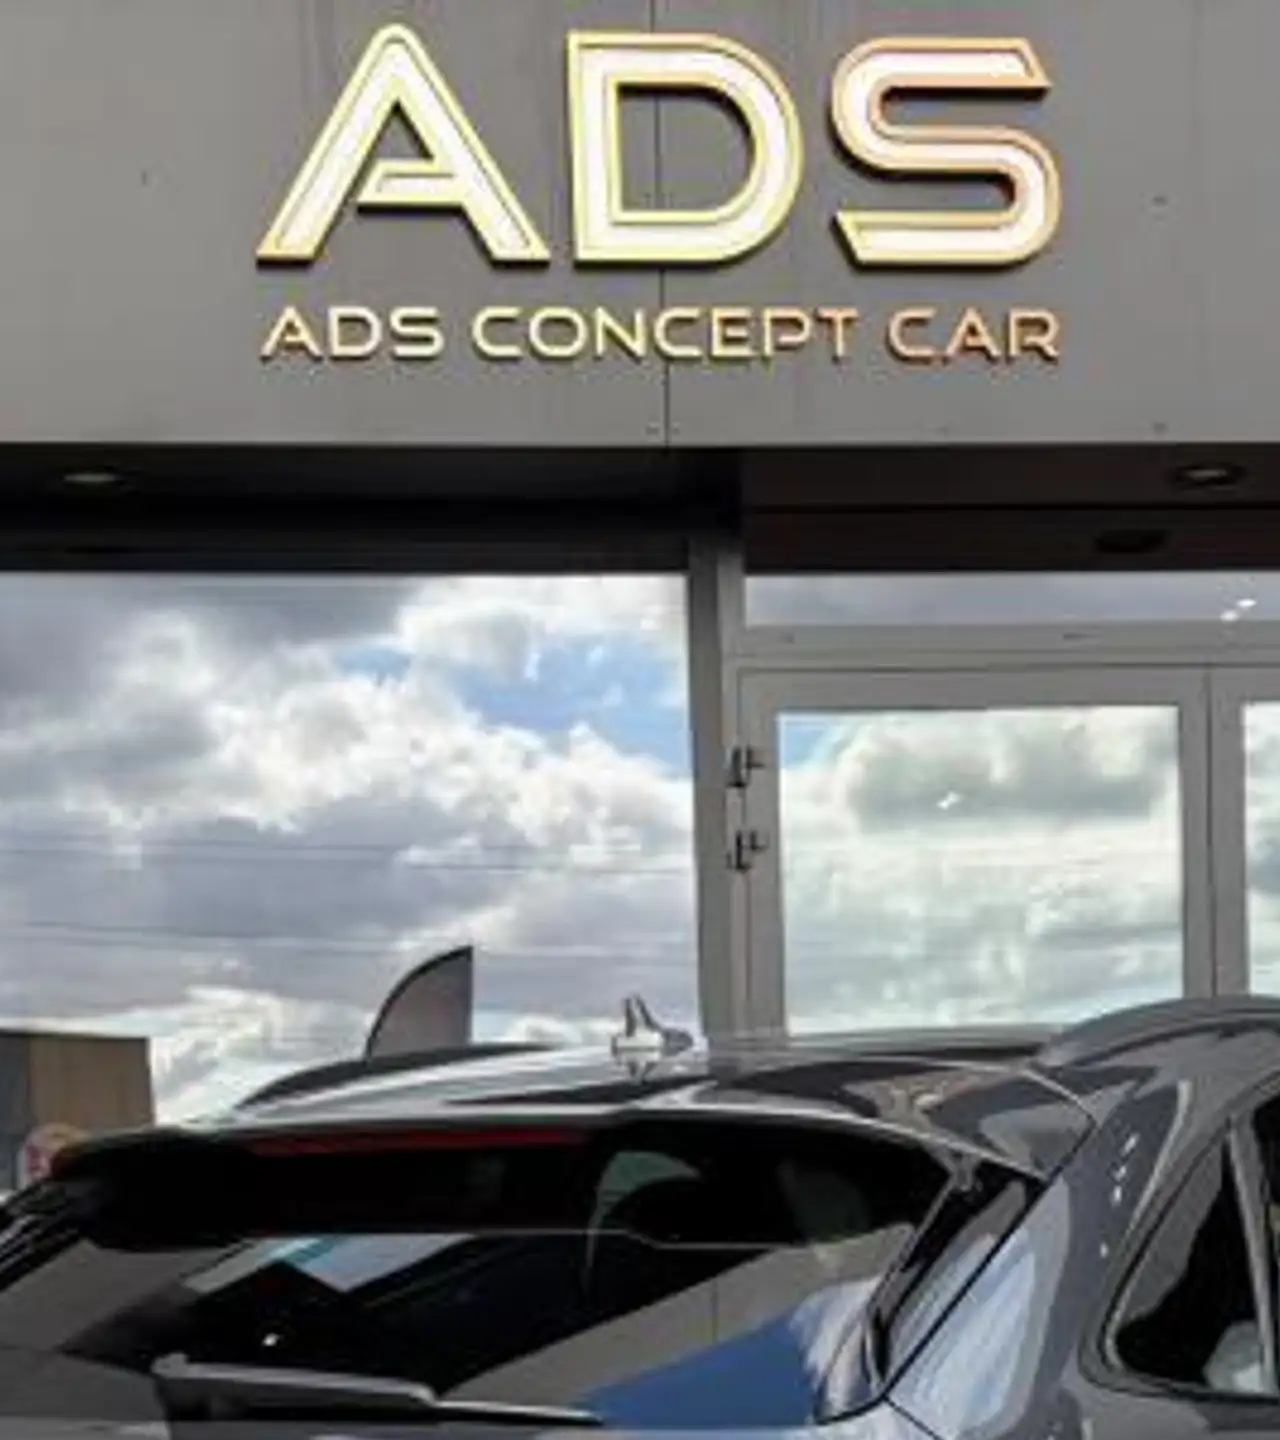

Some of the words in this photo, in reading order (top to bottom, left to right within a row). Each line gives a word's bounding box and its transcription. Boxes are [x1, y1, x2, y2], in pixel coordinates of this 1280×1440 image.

[256, 23, 1061, 266] ADS
[261, 306, 446, 361] ADS
[471, 307, 859, 361] CONCEPT
[886, 307, 1061, 362] CAR
